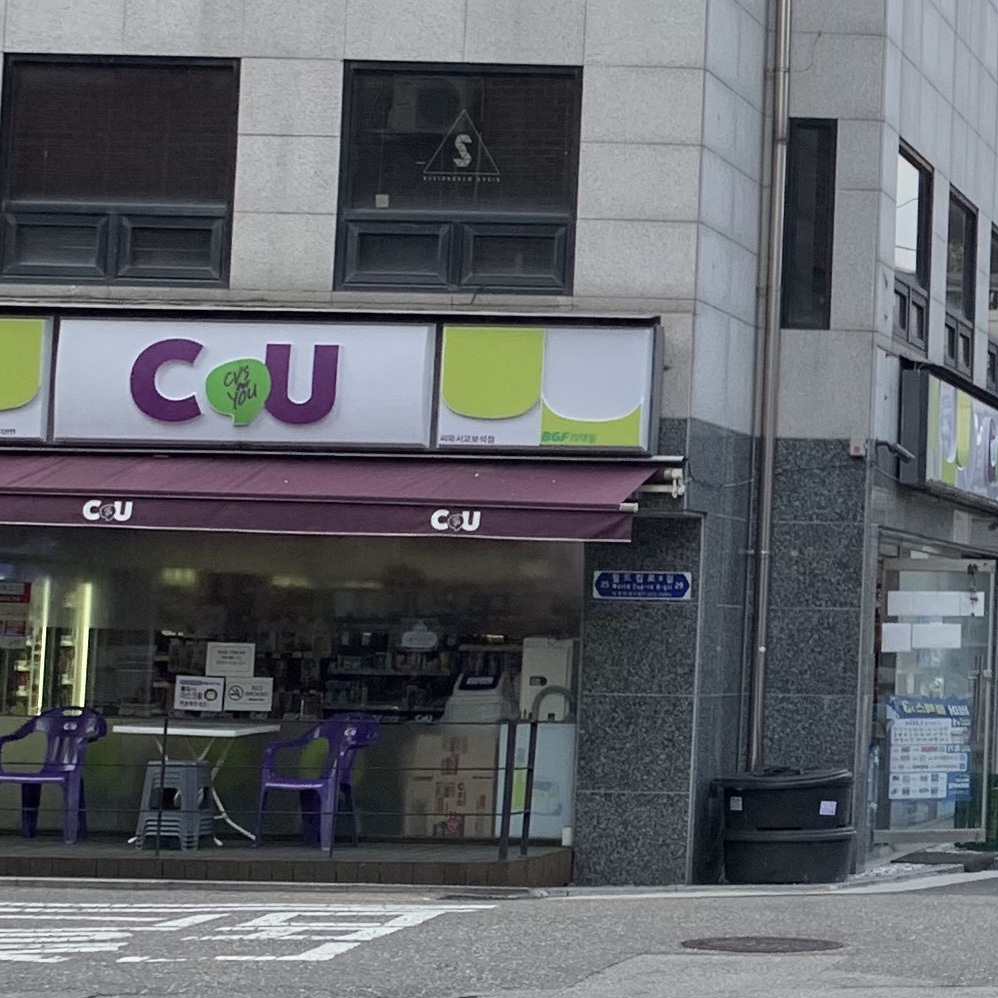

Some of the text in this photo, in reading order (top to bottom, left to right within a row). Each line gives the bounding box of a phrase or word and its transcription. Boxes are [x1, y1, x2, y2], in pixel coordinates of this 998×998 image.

[130, 338, 339, 425] CU
[227, 383, 257, 410] YOU
[541, 431, 569, 443] BGF
[83, 499, 133, 521] CU
[430, 509, 481, 531] CU
